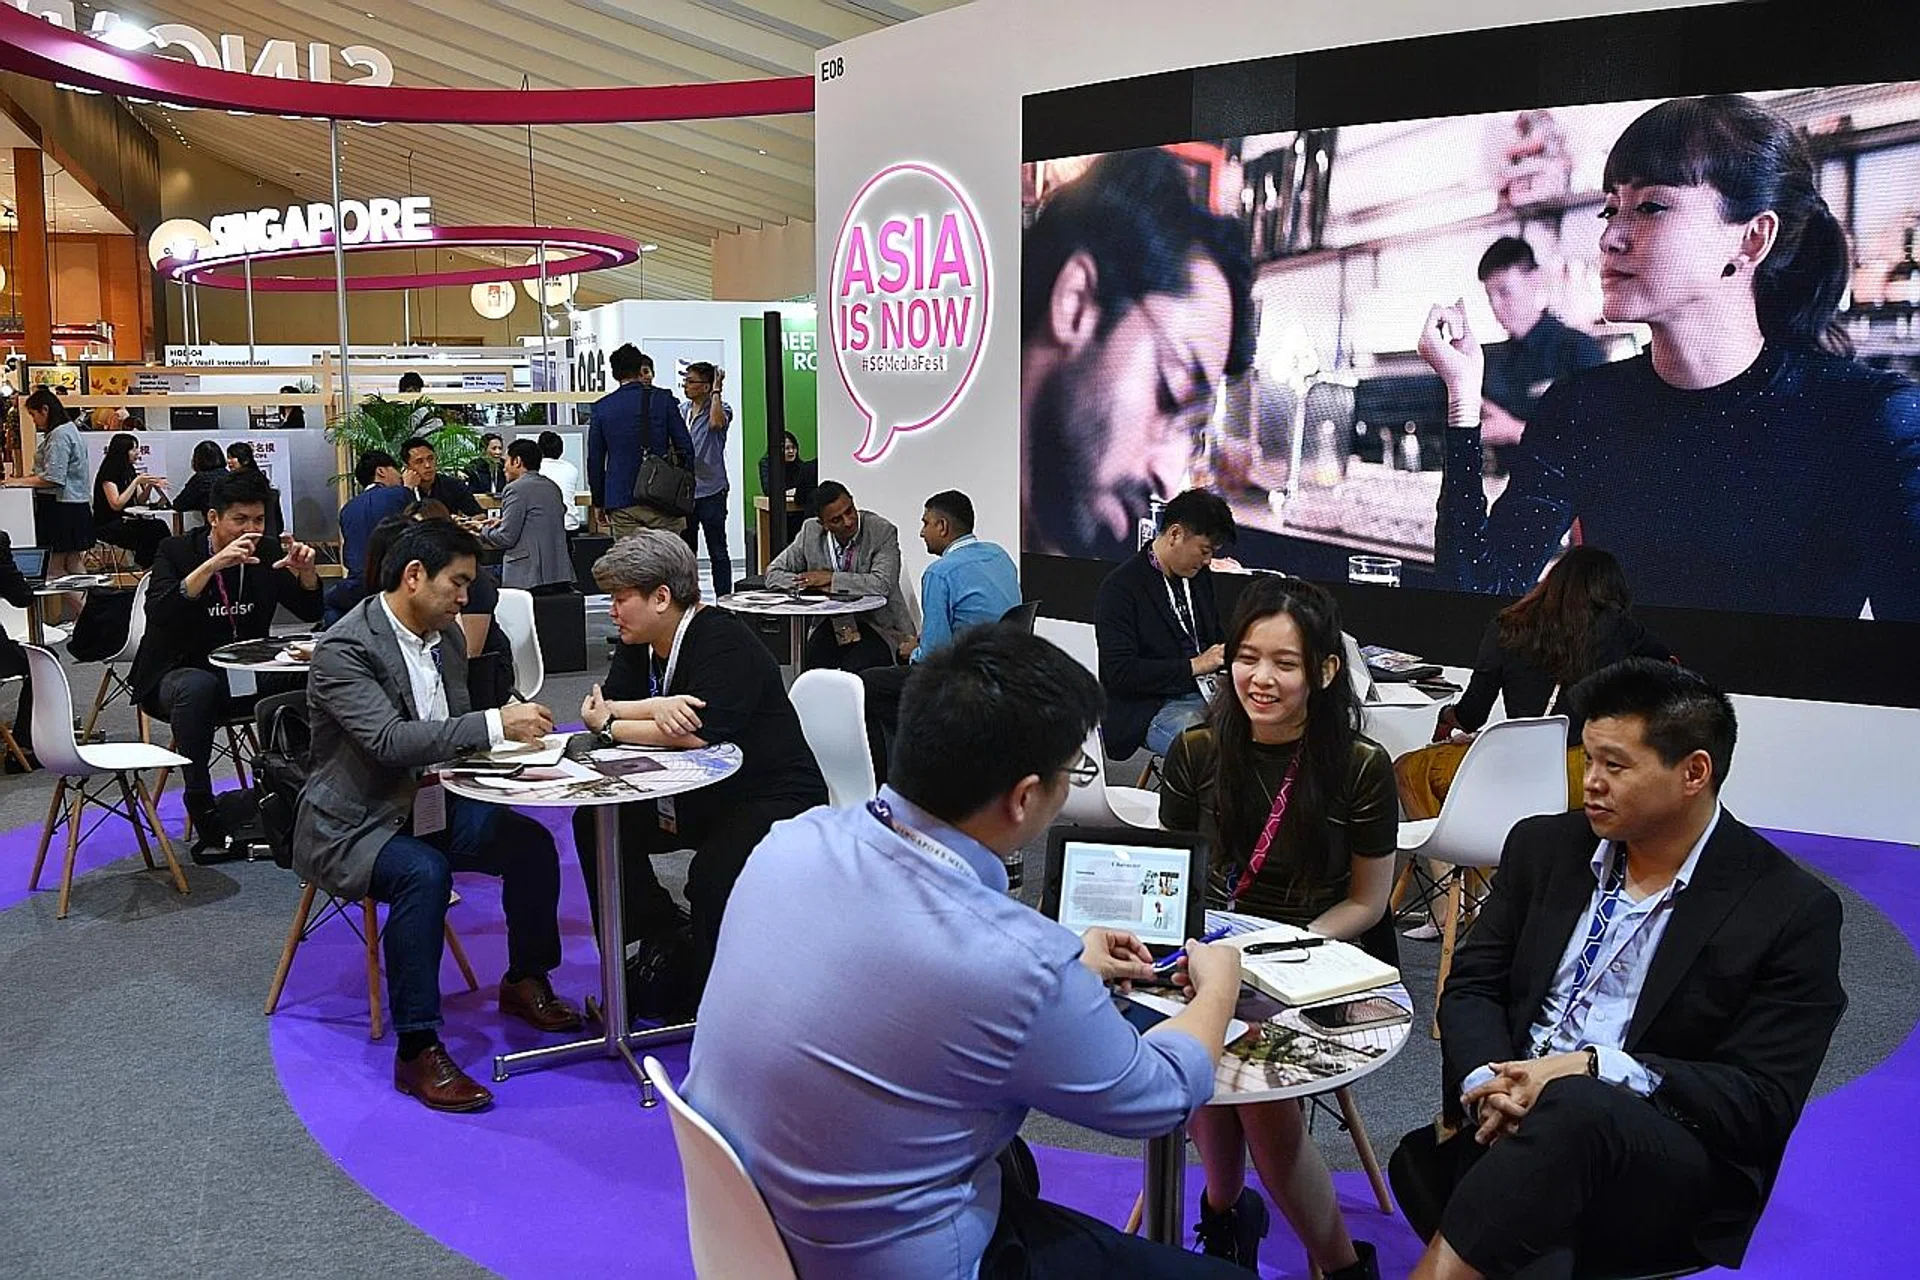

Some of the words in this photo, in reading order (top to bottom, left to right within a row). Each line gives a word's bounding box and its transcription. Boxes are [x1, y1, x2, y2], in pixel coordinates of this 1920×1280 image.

[207, 196, 433, 254] SINGAPORE
[841, 213, 972, 297] ASIA
[841, 303, 870, 351] IS
[881, 296, 972, 349] NOW
[862, 355, 944, 372] #SGMediaFest
